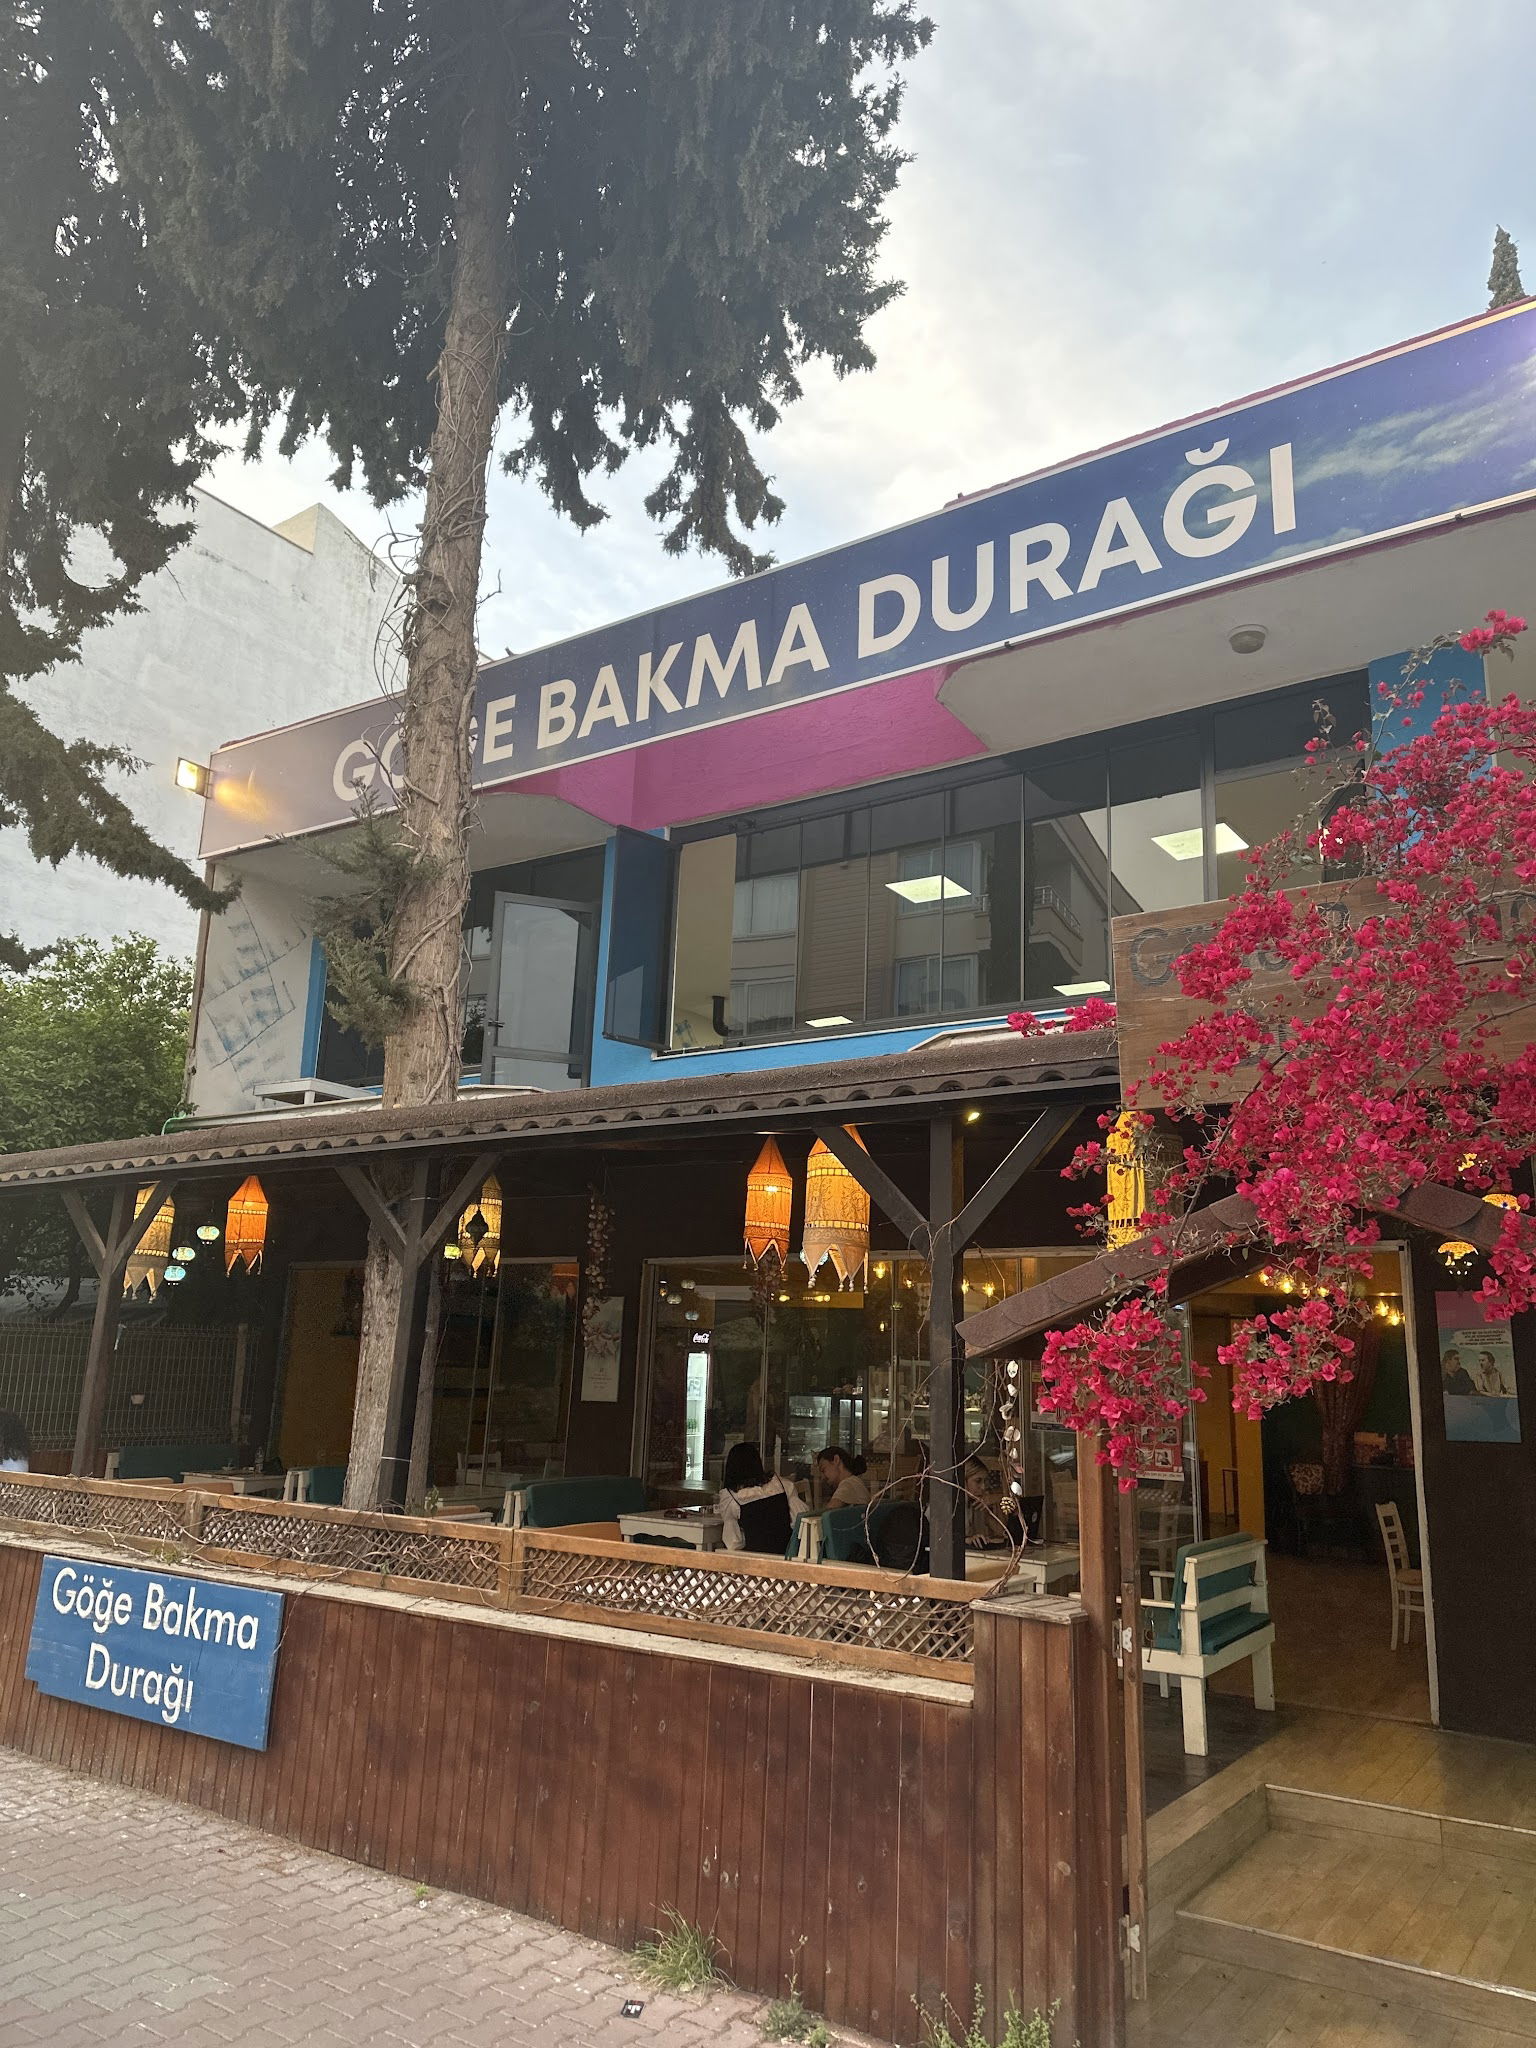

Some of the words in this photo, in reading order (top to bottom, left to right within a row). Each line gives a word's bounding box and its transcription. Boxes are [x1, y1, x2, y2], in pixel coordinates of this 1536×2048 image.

[333, 694, 517, 802] GÖE
[537, 603, 829, 749] BAKMA
[857, 438, 1297, 659] DURAĞI
[52, 1566, 132, 1634] Göğe
[142, 1582, 259, 1651] Bakma
[85, 1642, 194, 1725] Durağı
